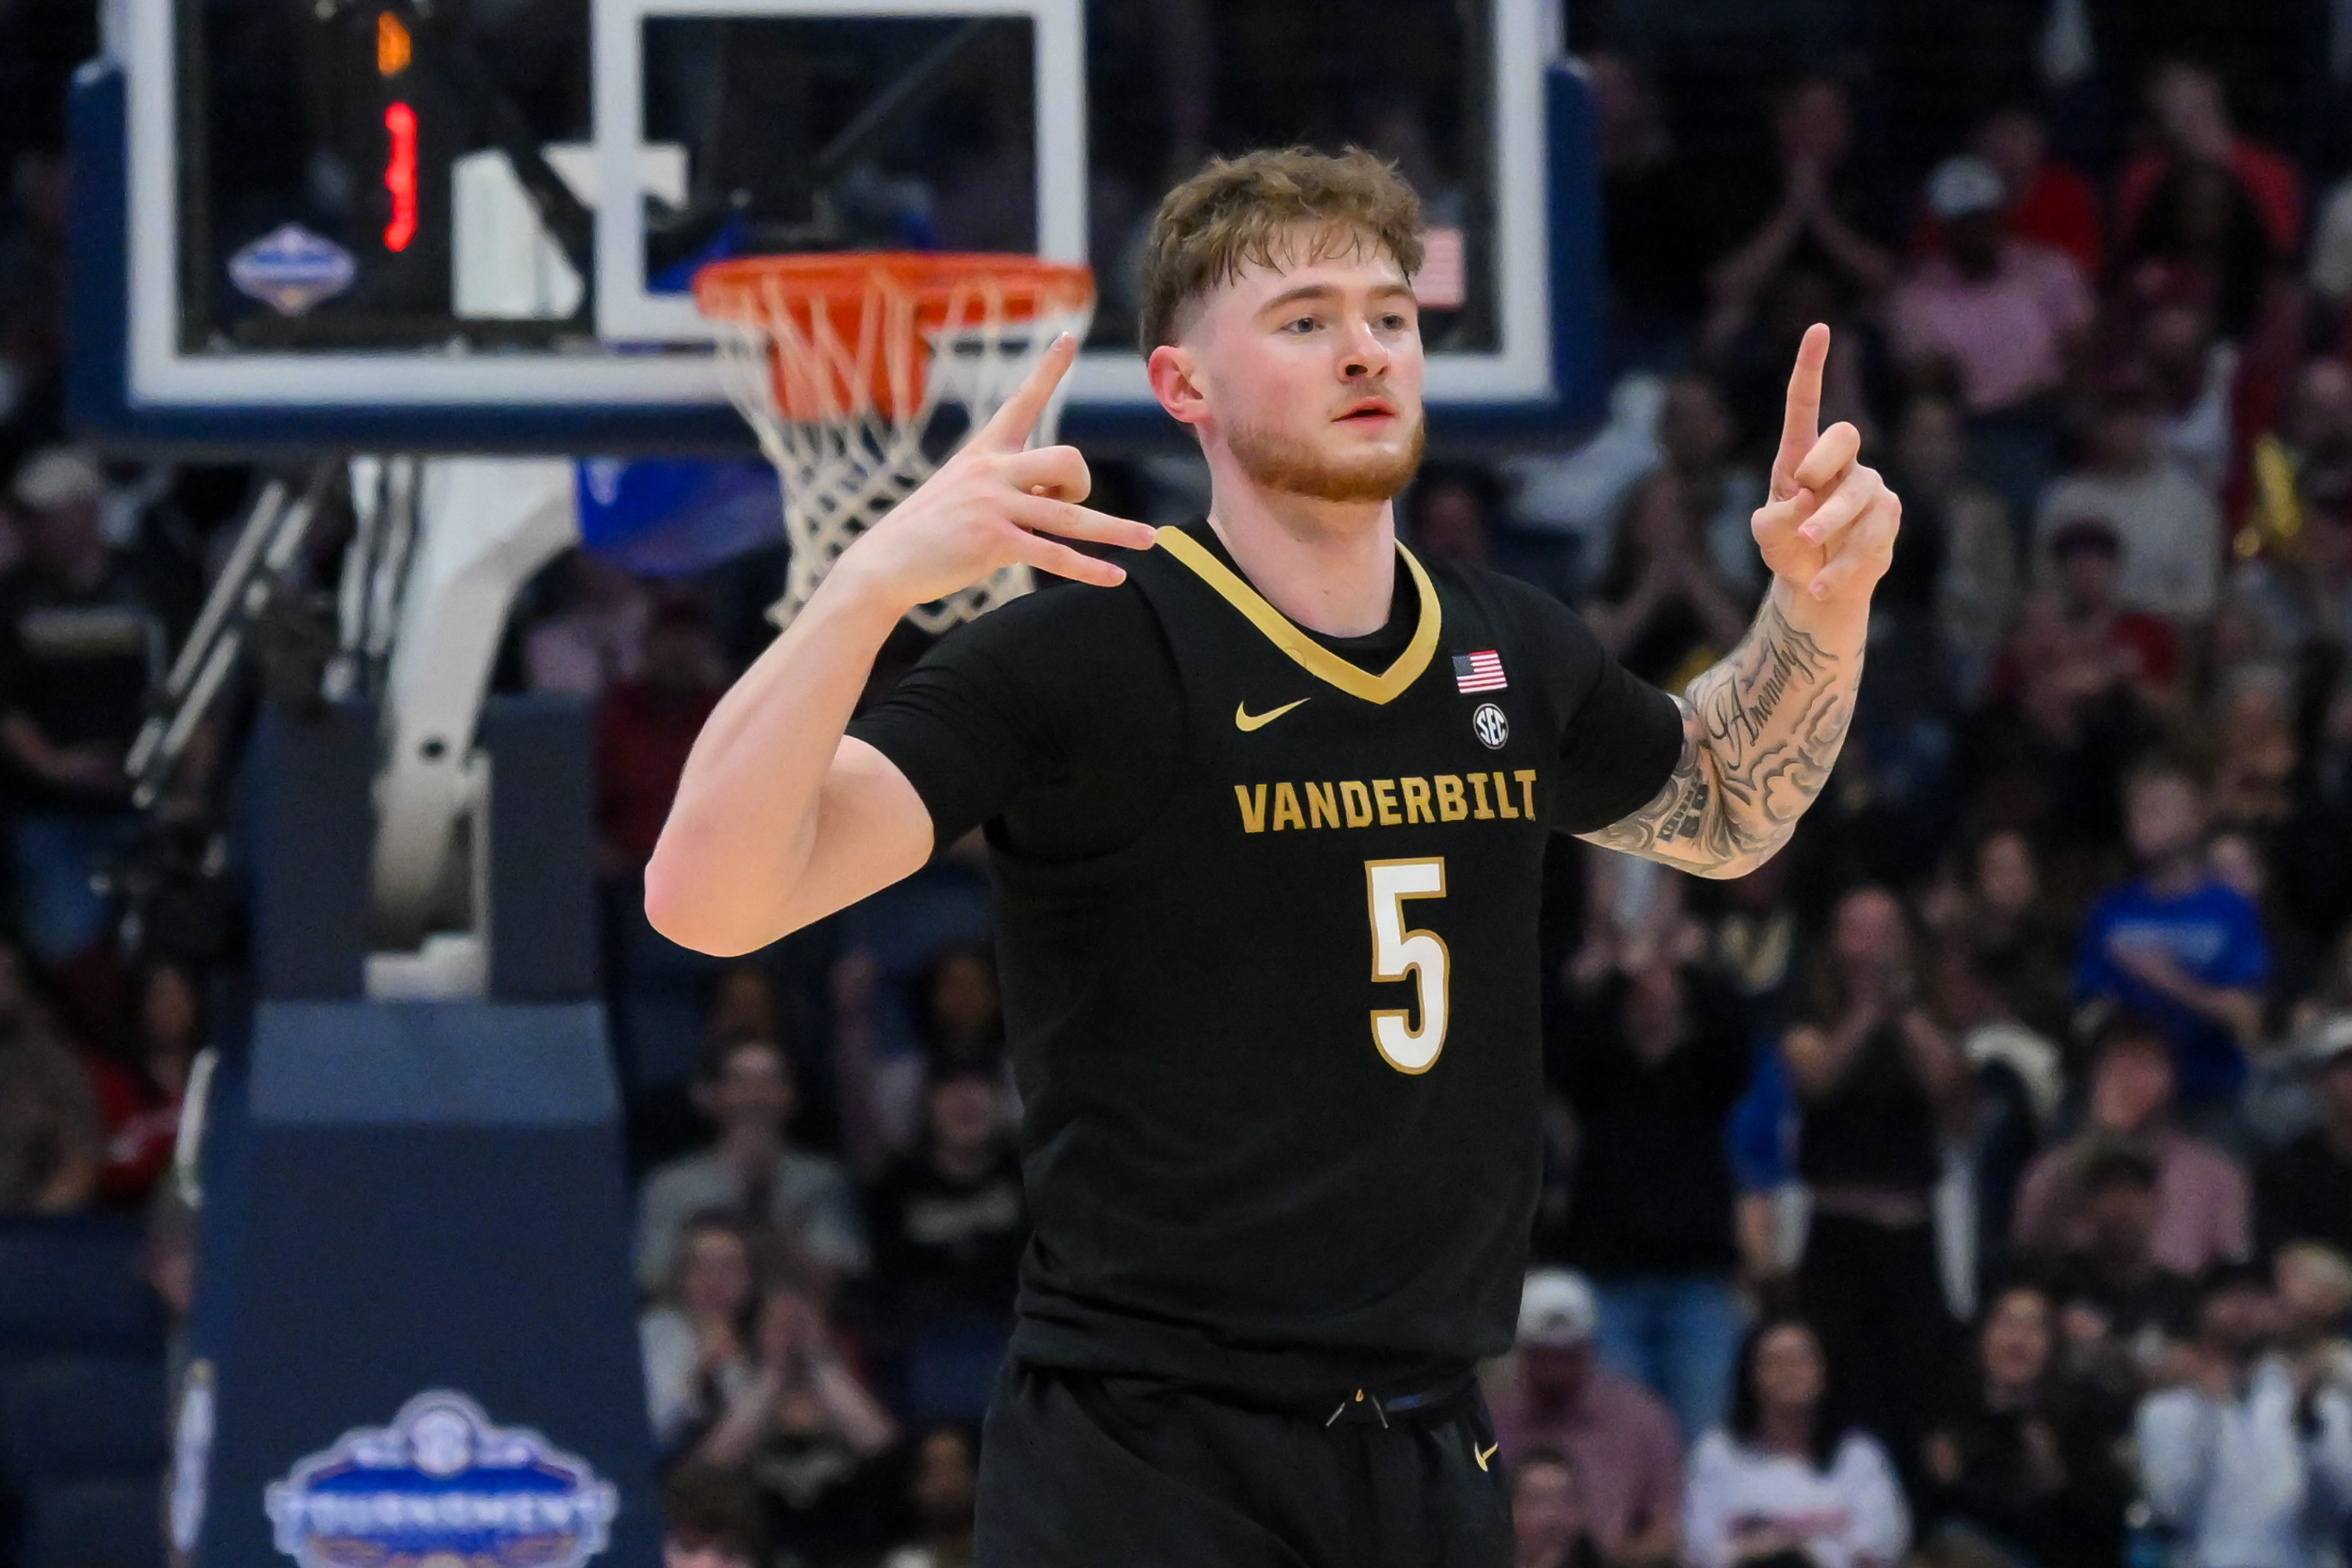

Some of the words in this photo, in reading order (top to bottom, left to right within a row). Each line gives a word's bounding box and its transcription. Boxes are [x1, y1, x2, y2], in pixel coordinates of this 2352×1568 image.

[1476, 707, 1506, 746] SEC
[1234, 769, 1538, 834] VANDERBILT
[1365, 857, 1450, 1075] 5
